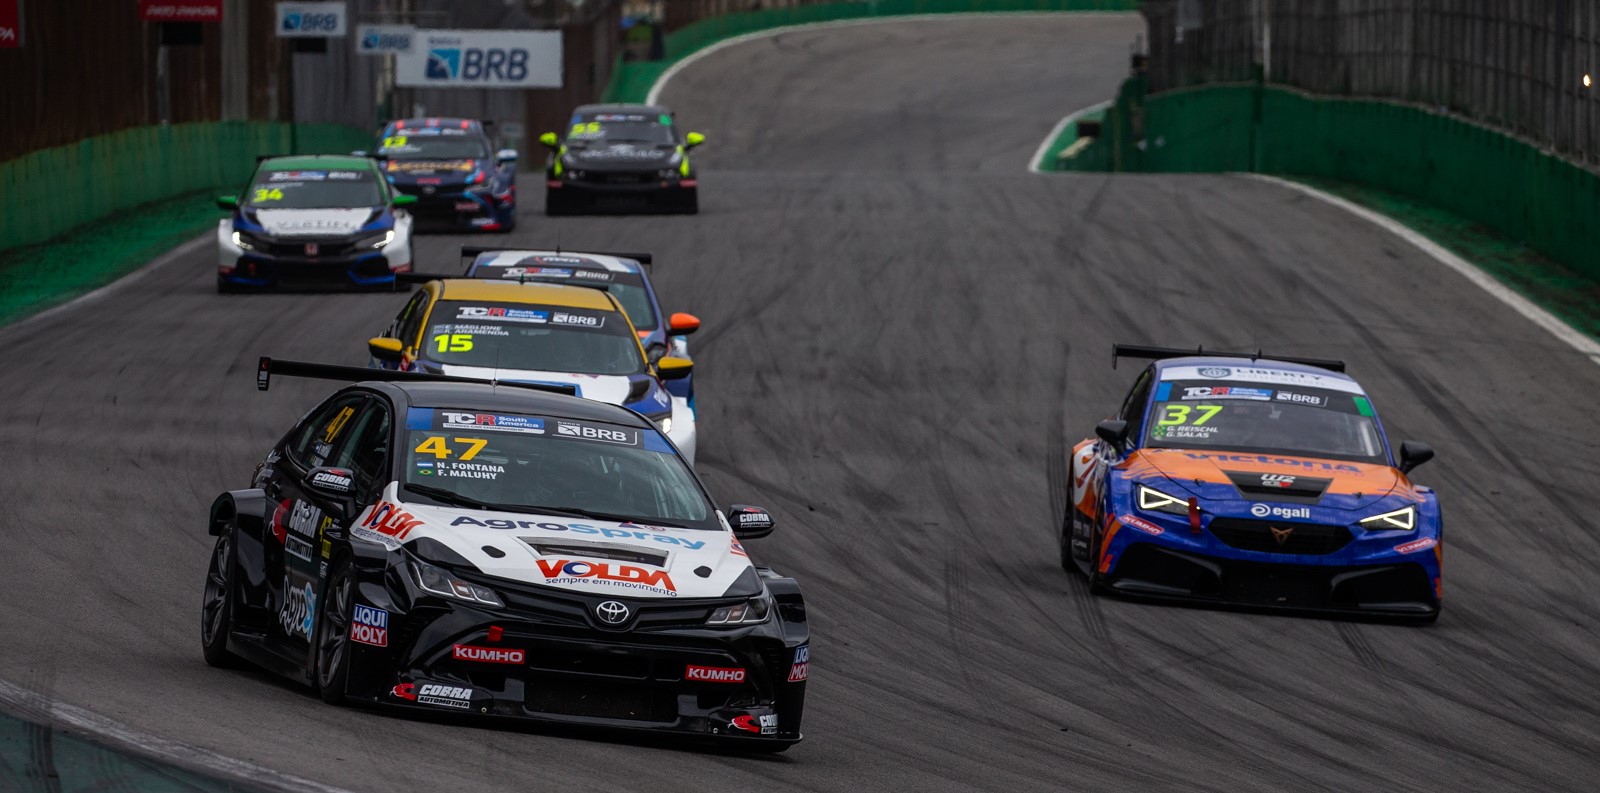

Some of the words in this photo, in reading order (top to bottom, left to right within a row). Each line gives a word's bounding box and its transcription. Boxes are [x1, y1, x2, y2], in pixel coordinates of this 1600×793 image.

[301, 13, 337, 31] BRB
[379, 34, 411, 50] BRB
[462, 48, 529, 80] BRB
[254, 188, 284, 203] 34
[458, 306, 507, 318] TCR
[567, 315, 597, 326] BRB
[433, 334, 474, 353] 15
[1183, 386, 1230, 396] TCR
[1291, 394, 1321, 405] BRB
[442, 412, 497, 426] TCR
[1158, 405, 1223, 425] 37
[498, 420, 539, 429] America
[582, 427, 627, 441] BRB
[415, 436, 489, 461] 47
[452, 462, 505, 473] FONTANA
[314, 472, 352, 486] COBRA
[449, 470, 498, 480] MALUHY
[740, 513, 770, 522] COBRA
[1272, 507, 1311, 520] egali
[450, 515, 706, 550] AgroSpray
[535, 559, 677, 592] VOLDA
[545, 577, 589, 585] sempre
[613, 581, 678, 598] movimento
[354, 606, 386, 628] LIQUI
[351, 623, 386, 644] MOLY
[455, 647, 523, 662] KUMHO
[687, 667, 745, 681] KUMHO
[419, 684, 473, 700] COBRA
[418, 695, 470, 708] AUTOMOTIVA
